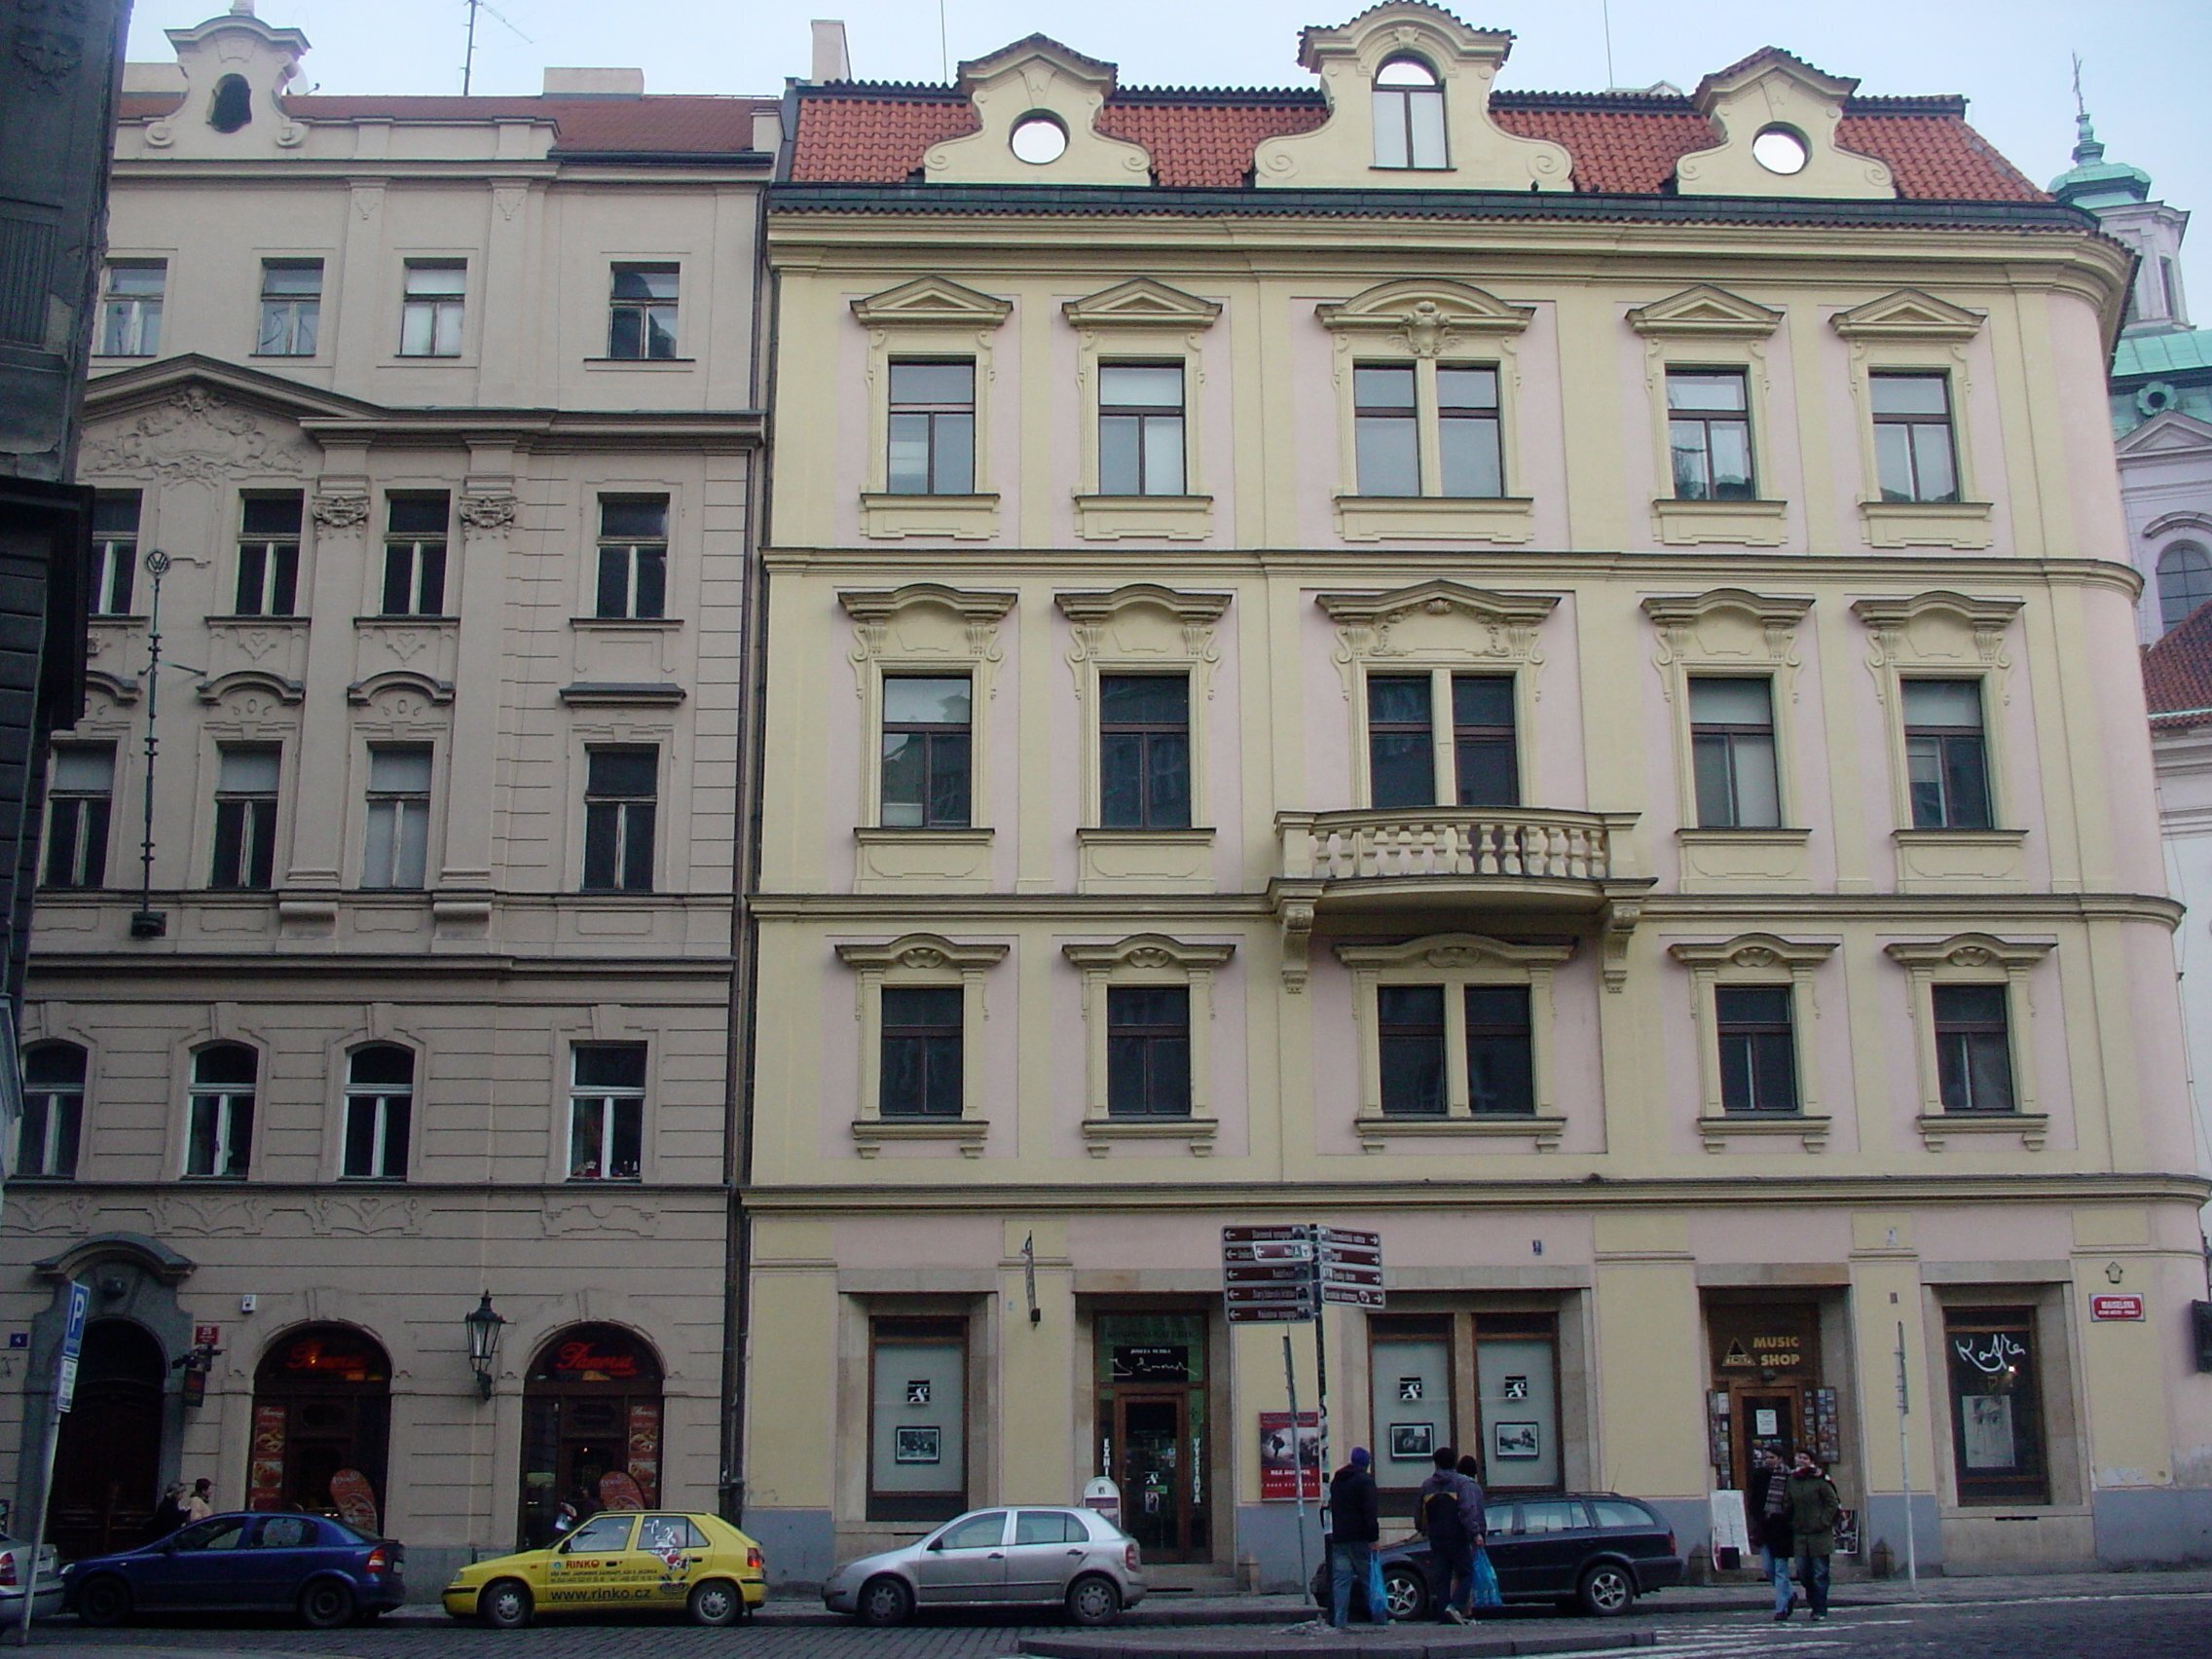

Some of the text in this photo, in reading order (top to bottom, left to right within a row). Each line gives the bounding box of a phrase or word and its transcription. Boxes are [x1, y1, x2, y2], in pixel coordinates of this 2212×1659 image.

[71, 1293, 86, 1332] P
[1753, 1336, 1799, 1348] MUSIC
[1761, 1354, 1800, 1366] SHOP
[566, 1560, 600, 1569] RINKO
[551, 1588, 651, 1600] www.rinko.cz
